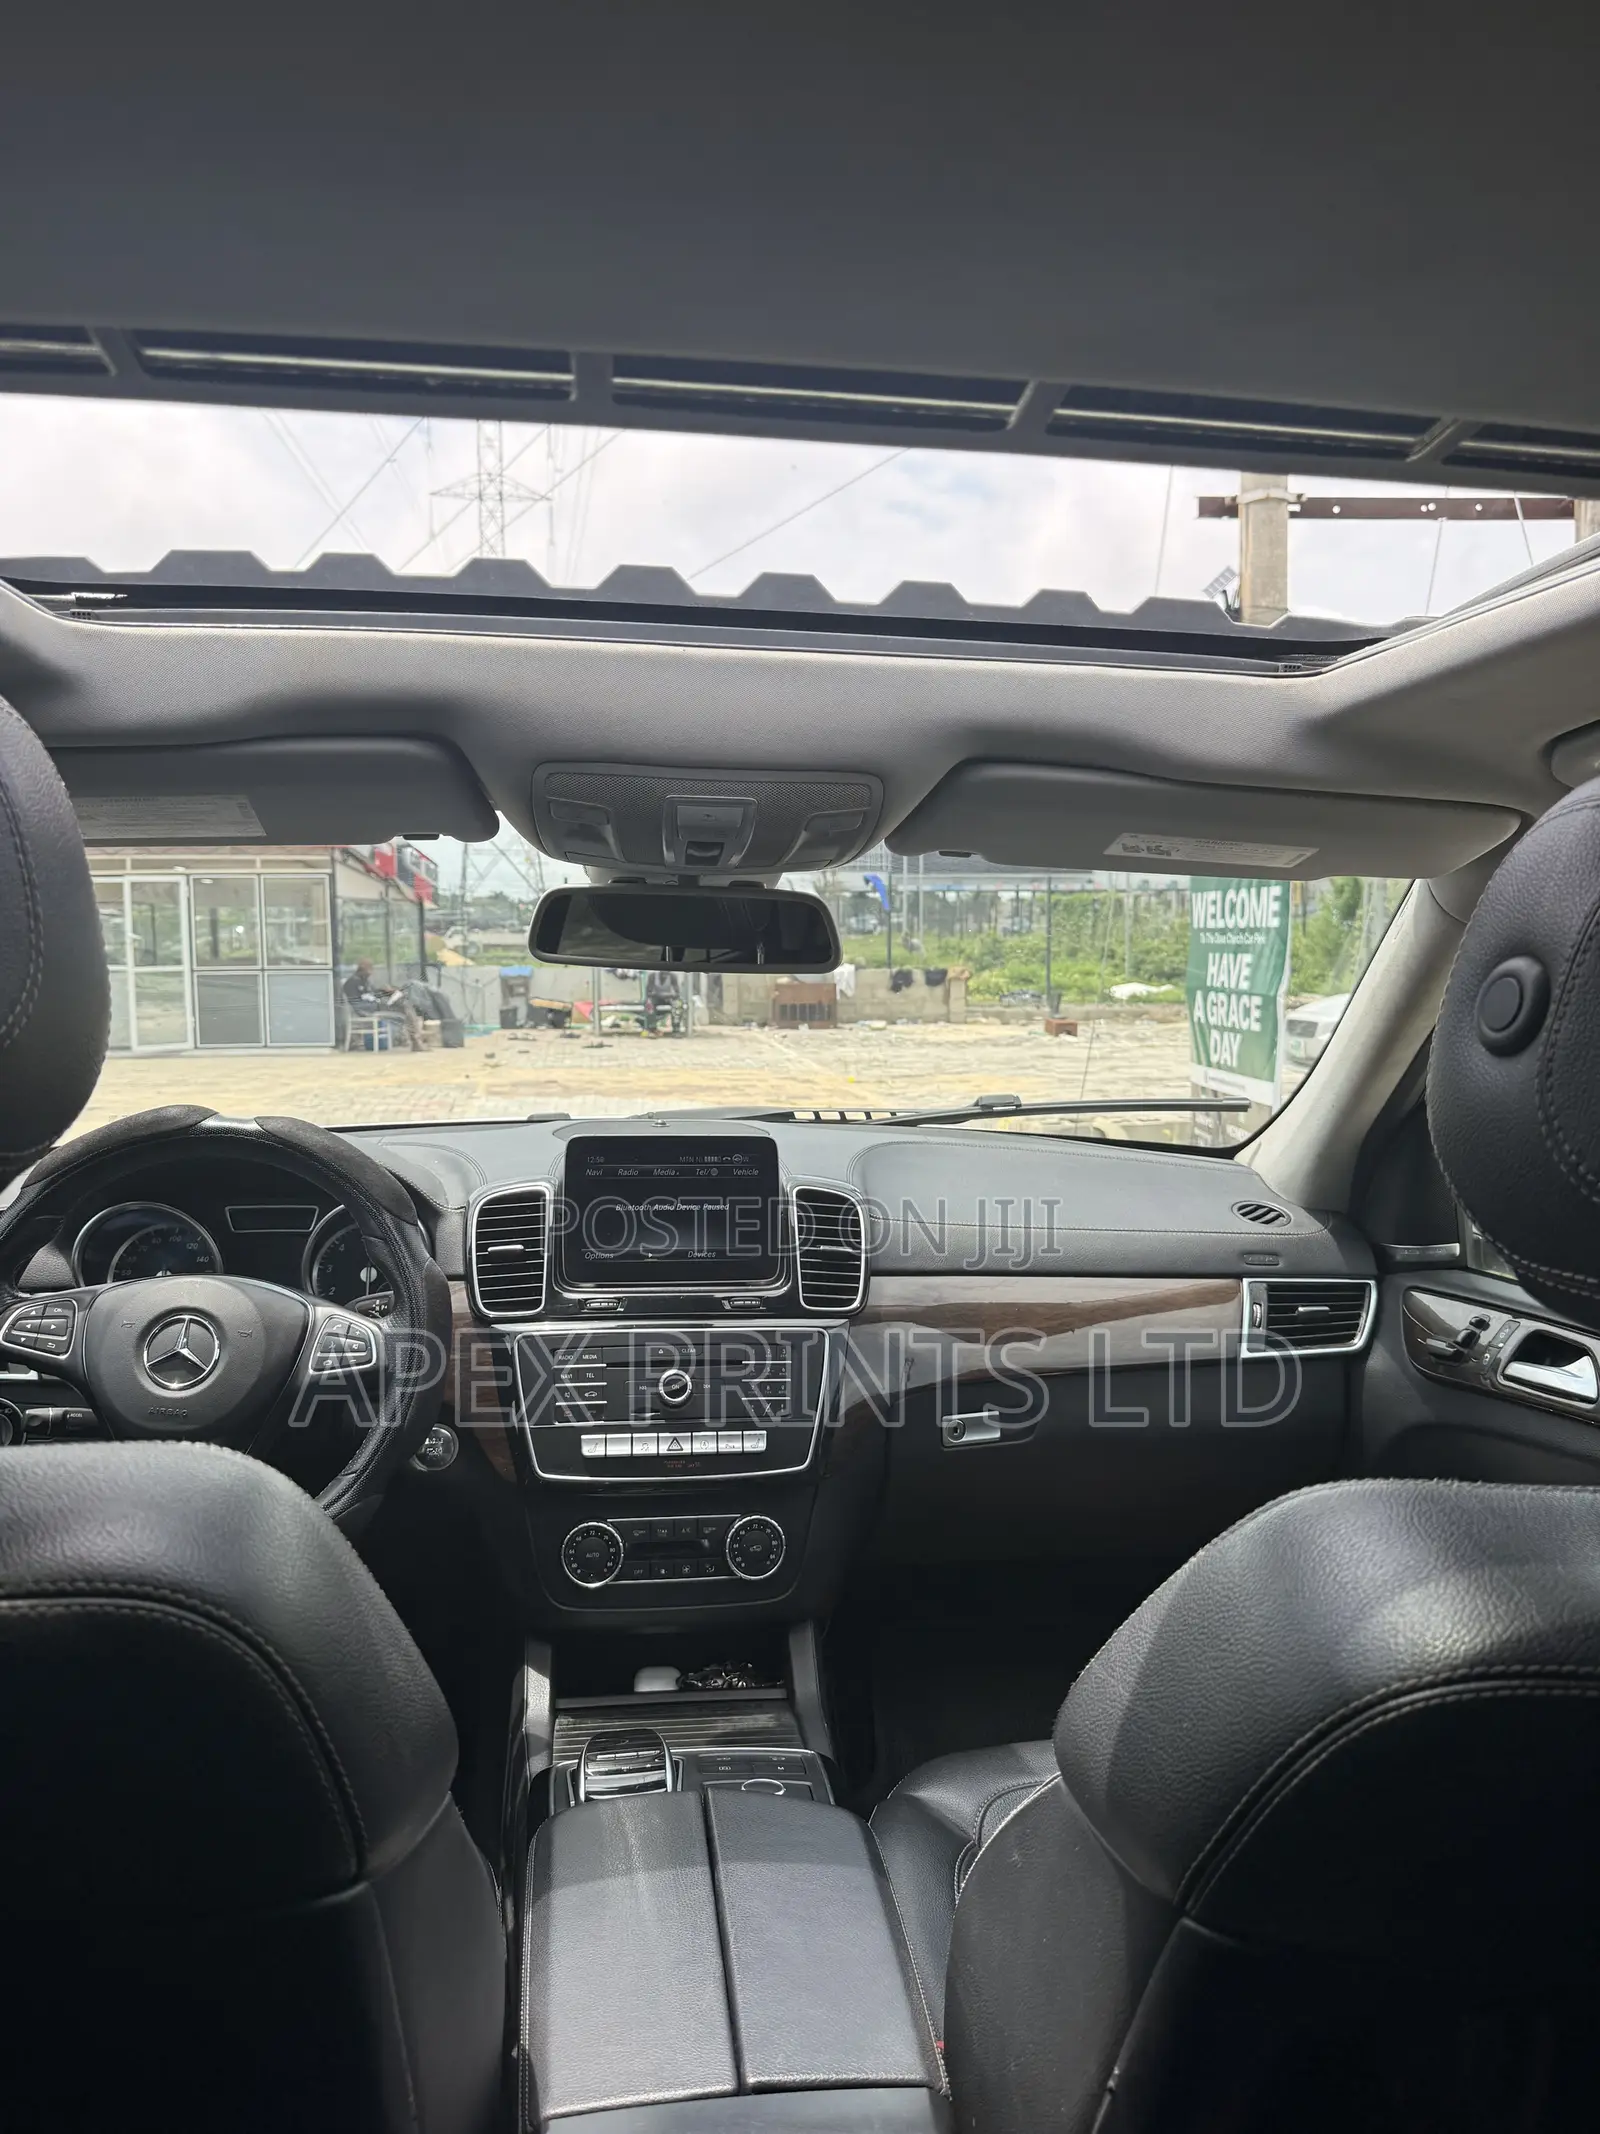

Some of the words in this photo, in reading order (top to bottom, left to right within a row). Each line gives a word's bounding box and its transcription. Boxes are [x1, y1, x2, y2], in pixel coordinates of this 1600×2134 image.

[1192, 886, 1283, 929] WELCOME
[1206, 953, 1253, 990] HAVE
[1193, 990, 1205, 1024] A
[1206, 992, 1263, 1032] GRACE
[1209, 1029, 1244, 1068] DAY
[585, 1168, 604, 1176] Navi
[617, 1168, 639, 1176] Radio
[652, 1168, 676, 1176] Media
[732, 1168, 760, 1176] Vehicle
[615, 1203, 651, 1212] Bluetooth
[652, 1203, 675, 1212] Audio
[676, 1203, 701, 1212] Device
[702, 1203, 730, 1212] Paused
[584, 1251, 614, 1260] Options
[687, 1250, 717, 1259] Devices
[328, 1286, 336, 1296] 2
